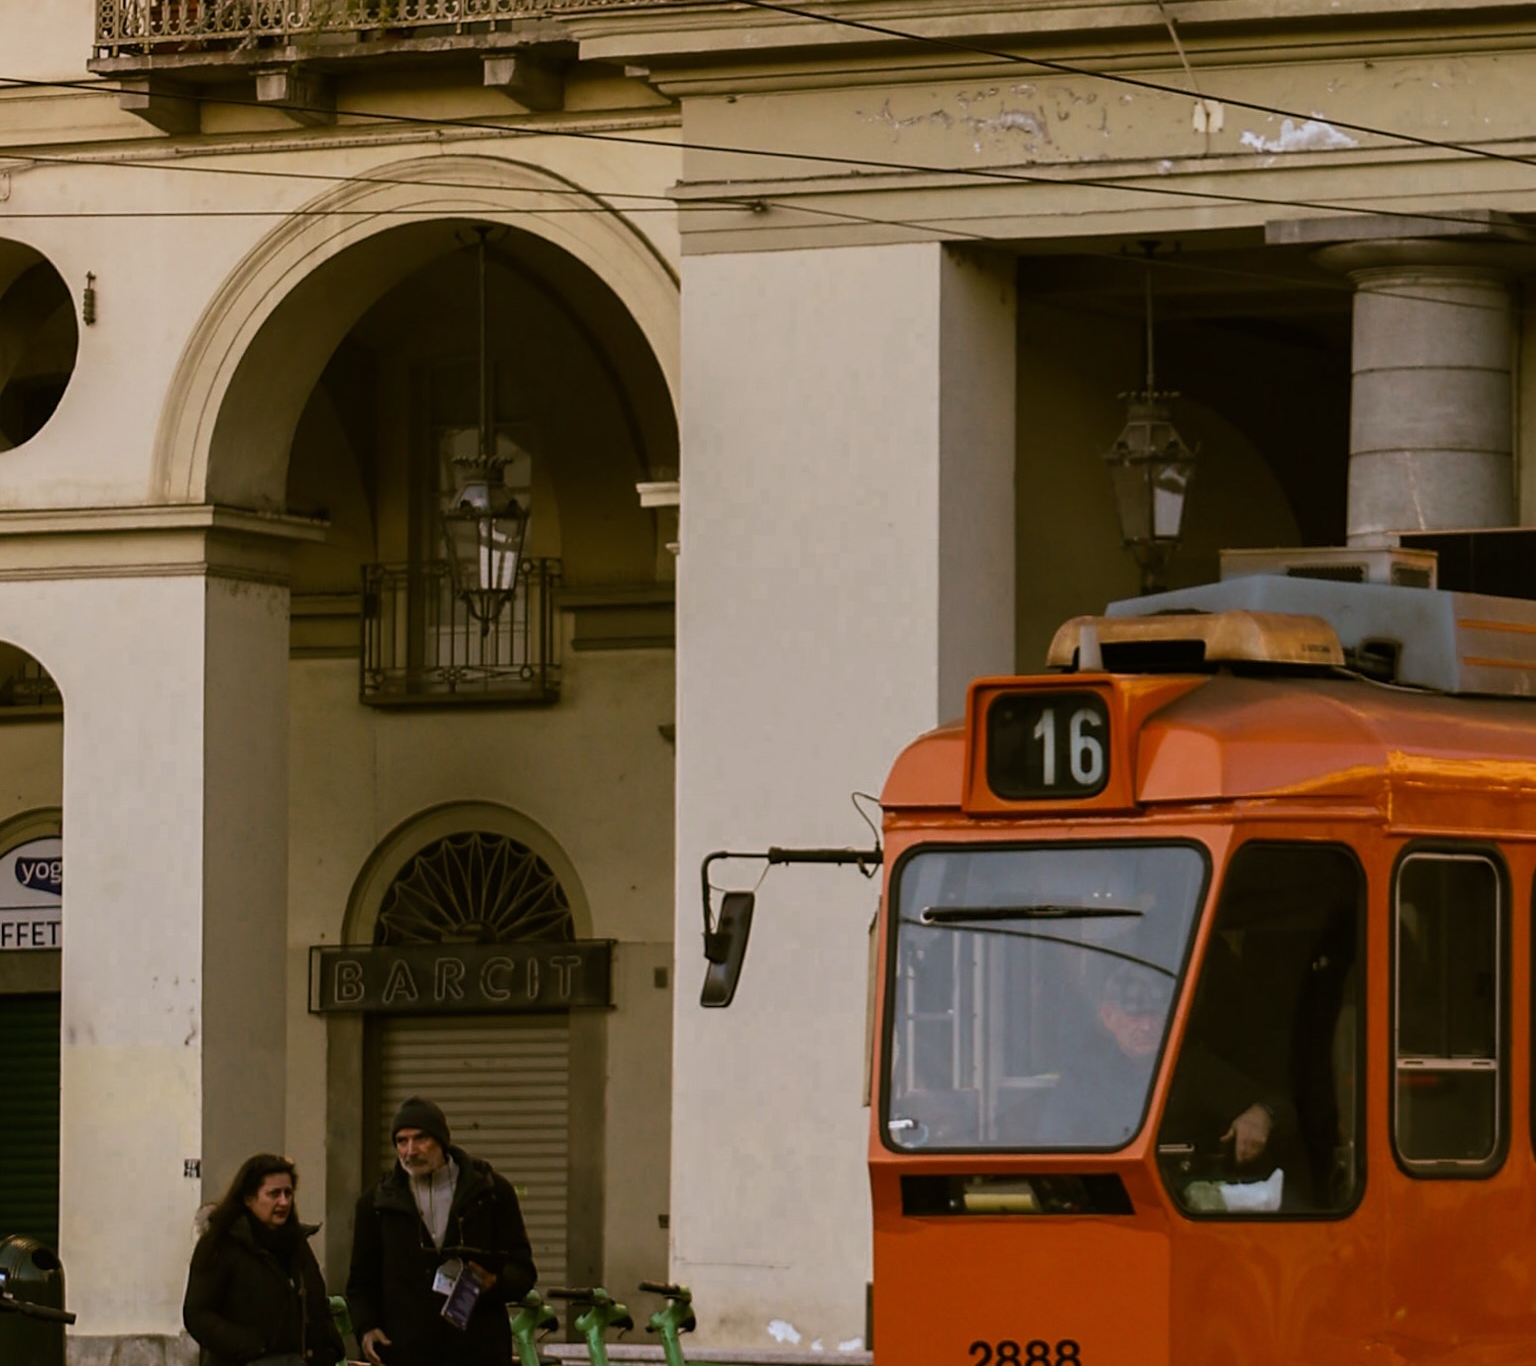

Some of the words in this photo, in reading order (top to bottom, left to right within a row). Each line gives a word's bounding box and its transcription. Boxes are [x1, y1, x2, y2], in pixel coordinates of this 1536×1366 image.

[1033, 707, 1103, 786] 16
[21, 861, 62, 885] yog
[1, 921, 61, 947] FFET
[334, 956, 582, 1003] BARCIT
